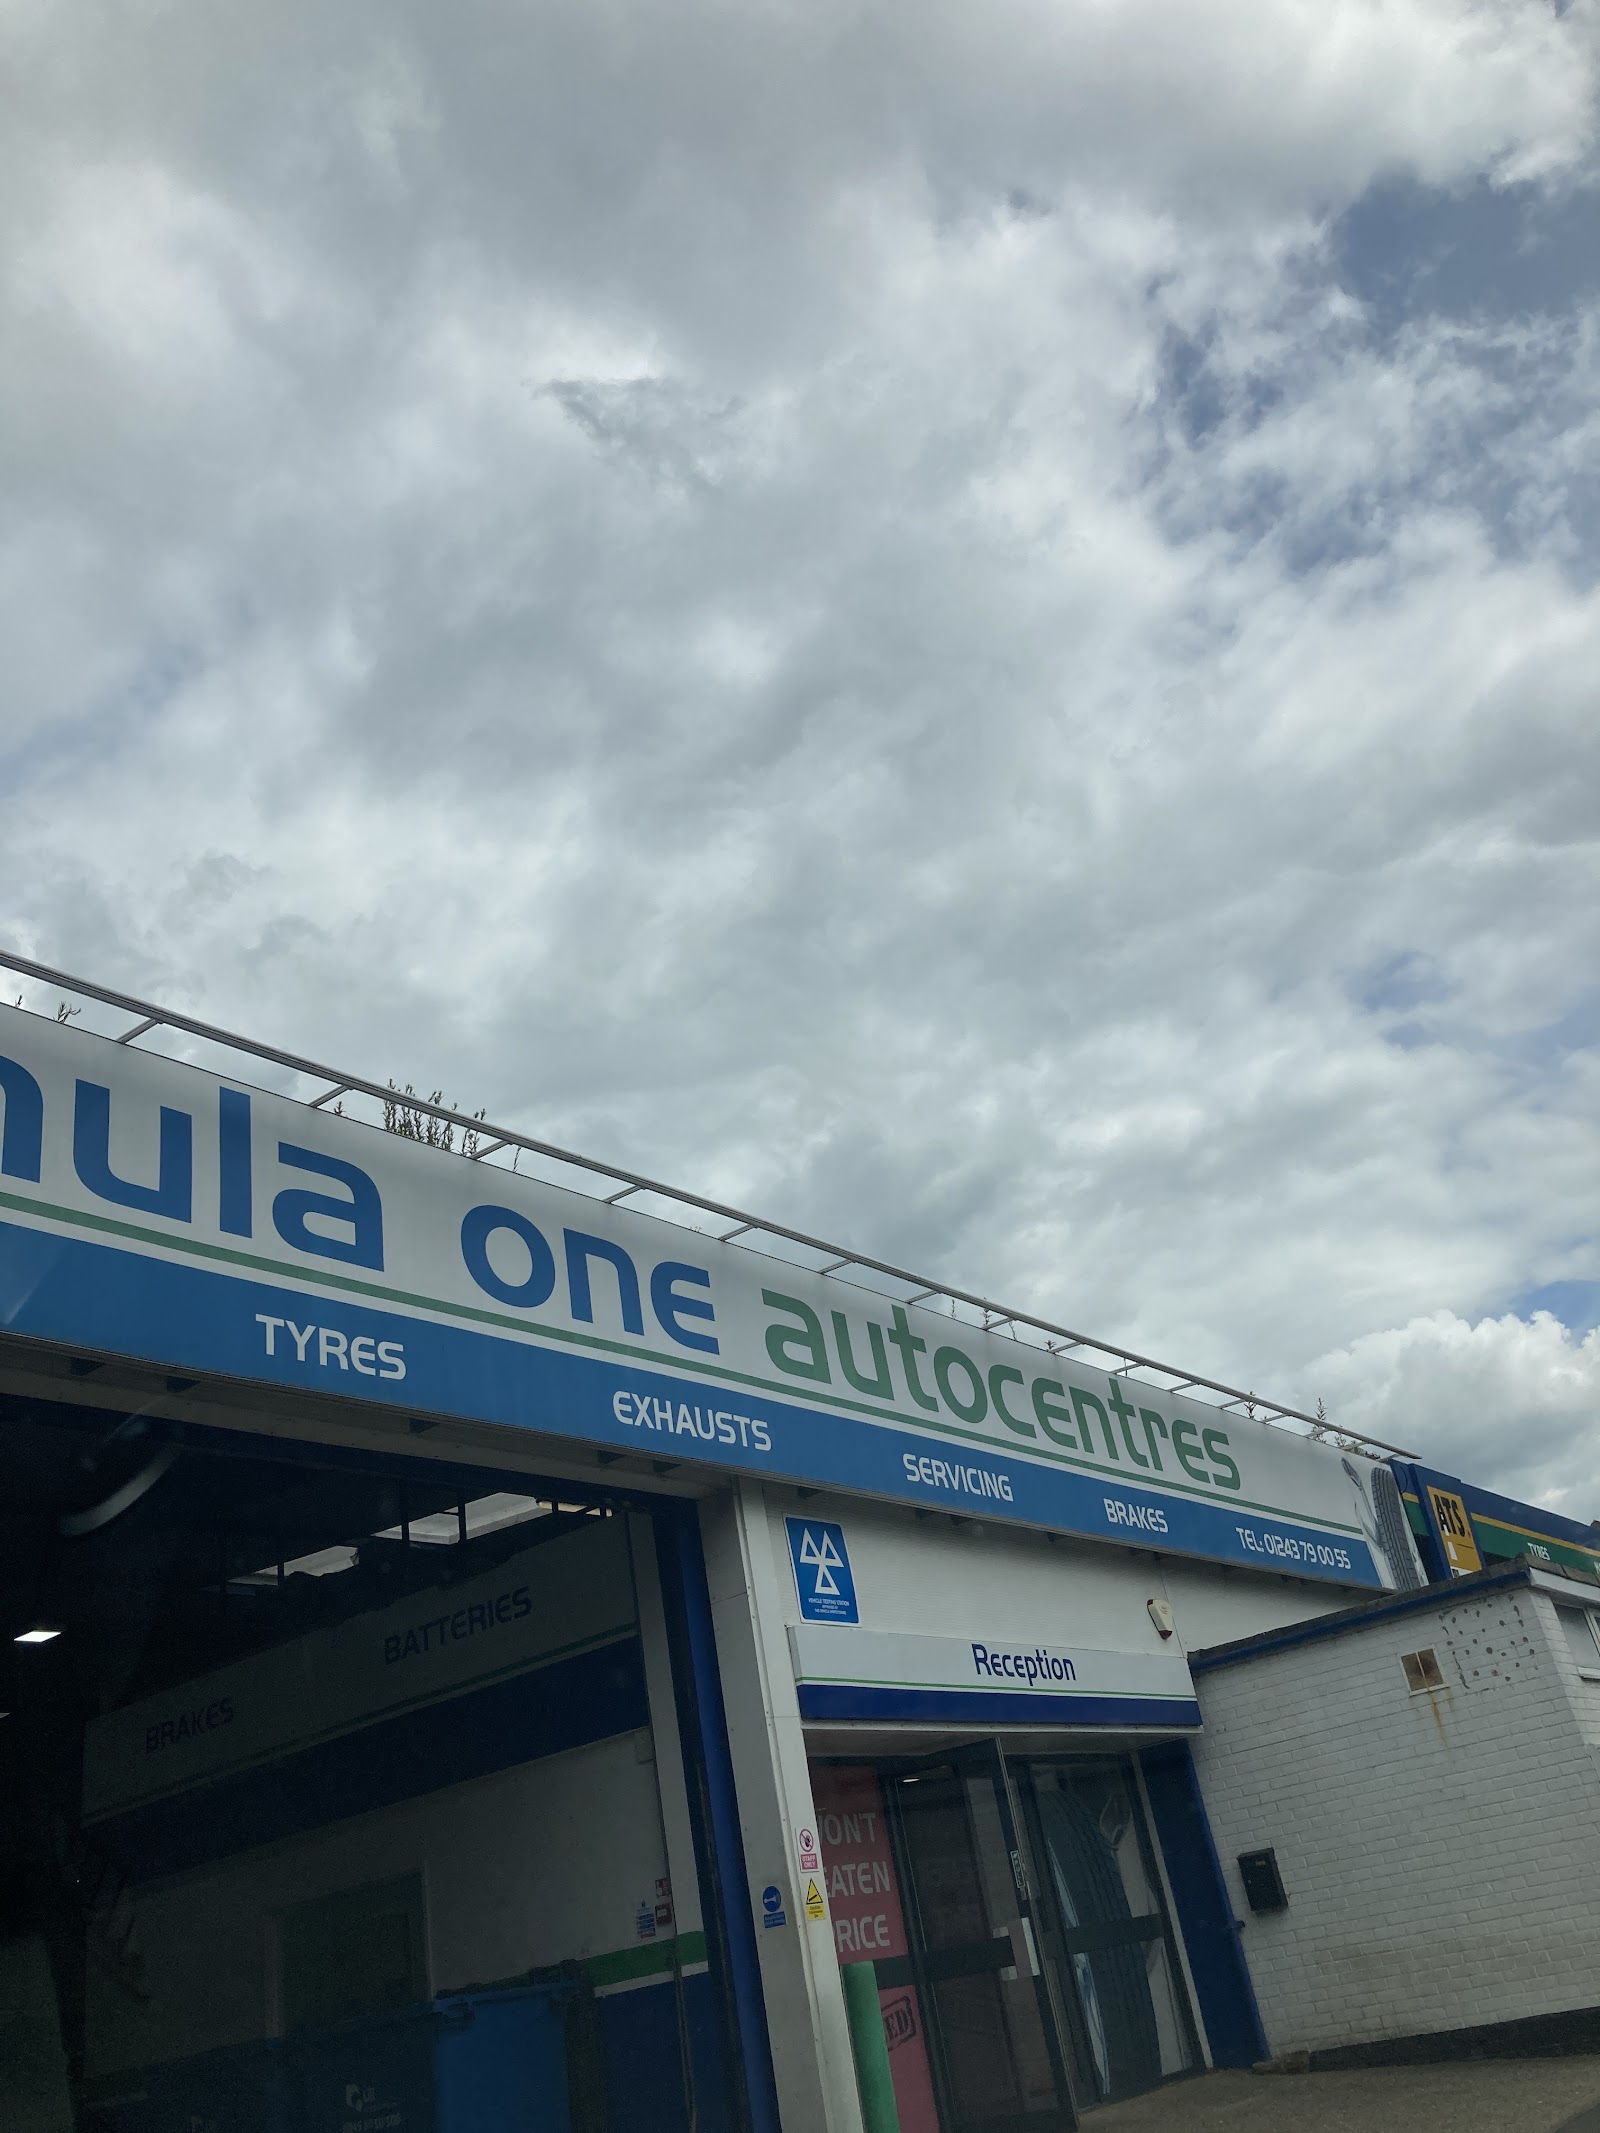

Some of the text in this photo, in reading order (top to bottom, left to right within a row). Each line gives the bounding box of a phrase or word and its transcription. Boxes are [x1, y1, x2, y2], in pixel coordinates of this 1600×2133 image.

[256, 1313, 407, 1380] TYRES
[461, 1204, 720, 1355] one
[761, 1288, 1241, 1491] autocentres
[612, 1390, 772, 1452] EXHAUSTS
[902, 1453, 1014, 1502] SERVICING
[1103, 1498, 1169, 1533] BRAKES
[1433, 1494, 1466, 1538] ATS
[1263, 1533, 1301, 1560] 01243
[1299, 1541, 1317, 1563] 79
[1316, 1544, 1335, 1567] 00
[1333, 1548, 1352, 1570] 55
[1527, 1542, 1551, 1561] TYRES
[383, 1585, 533, 1666] BATTERIES
[971, 1643, 1077, 1687] Reception
[144, 1698, 236, 1754] BRAKES
[802, 1854, 815, 1862] STAFF
[803, 1860, 816, 1868] ONLY
[834, 1914, 891, 1953] RICE
